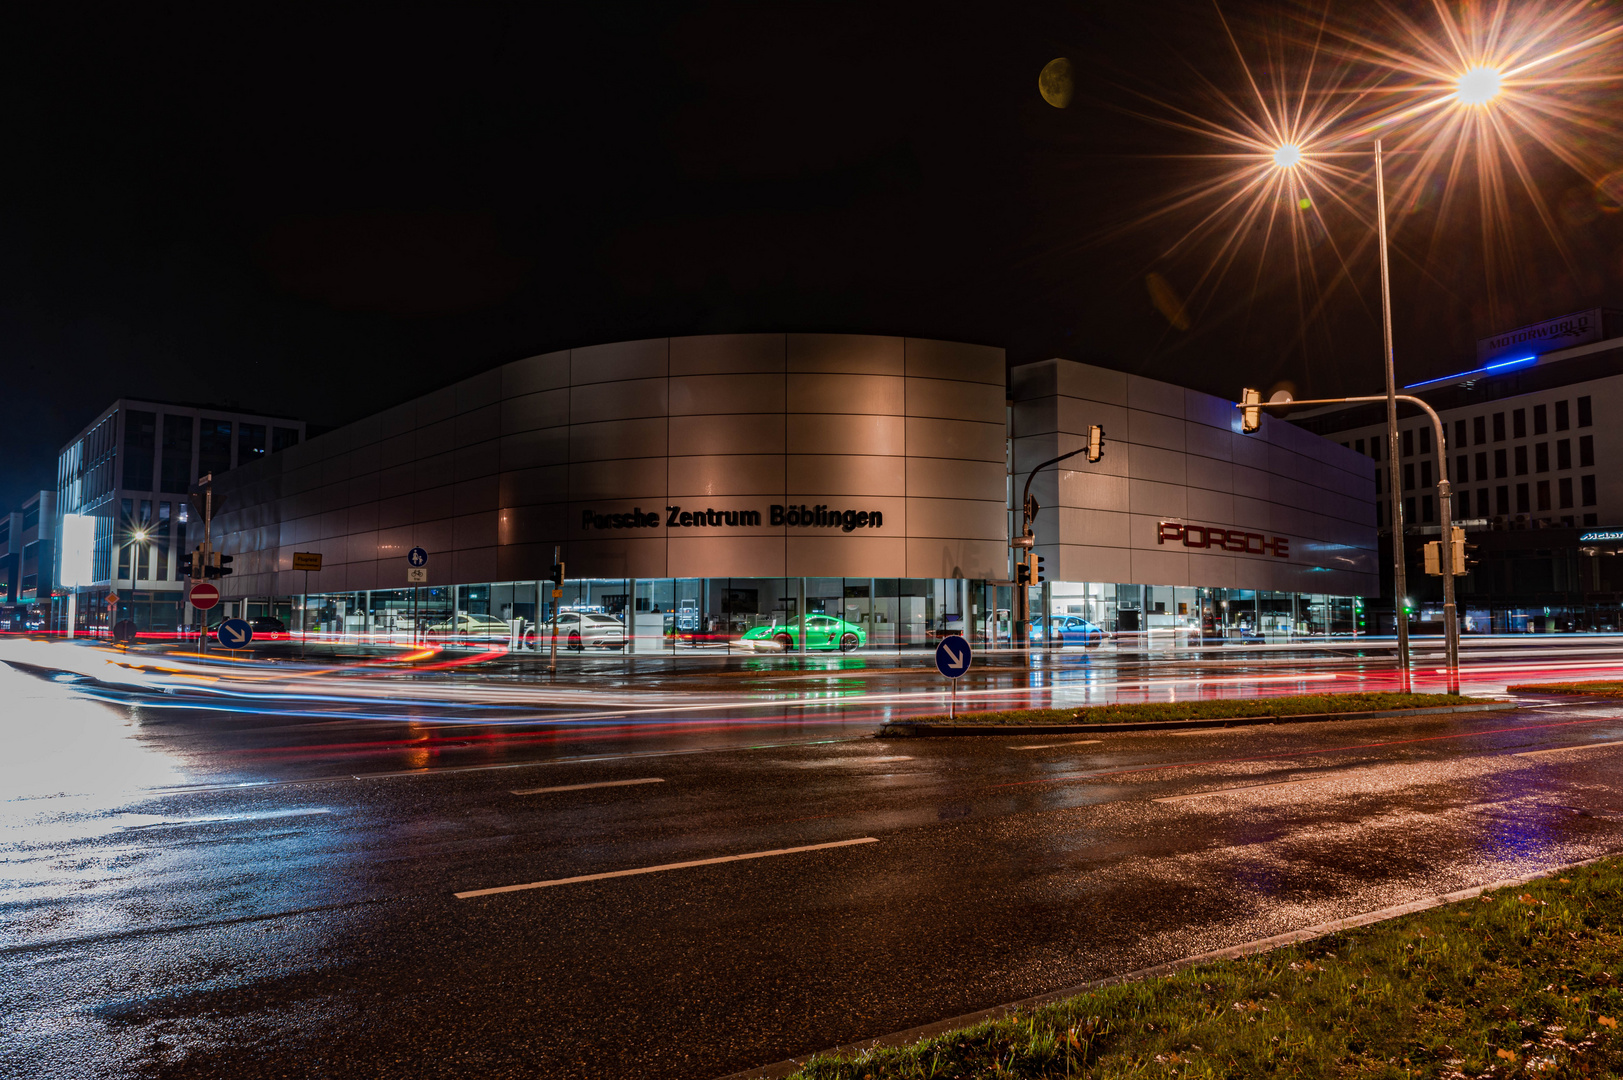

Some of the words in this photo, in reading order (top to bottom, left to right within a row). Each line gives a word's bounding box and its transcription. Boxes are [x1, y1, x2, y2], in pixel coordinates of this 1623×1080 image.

[1489, 316, 1588, 350] MOTORWORLD
[582, 507, 659, 530] Porsche
[666, 505, 761, 527] Zentrum
[769, 504, 884, 532] Böblingen
[1157, 521, 1289, 558] PORSCHE
